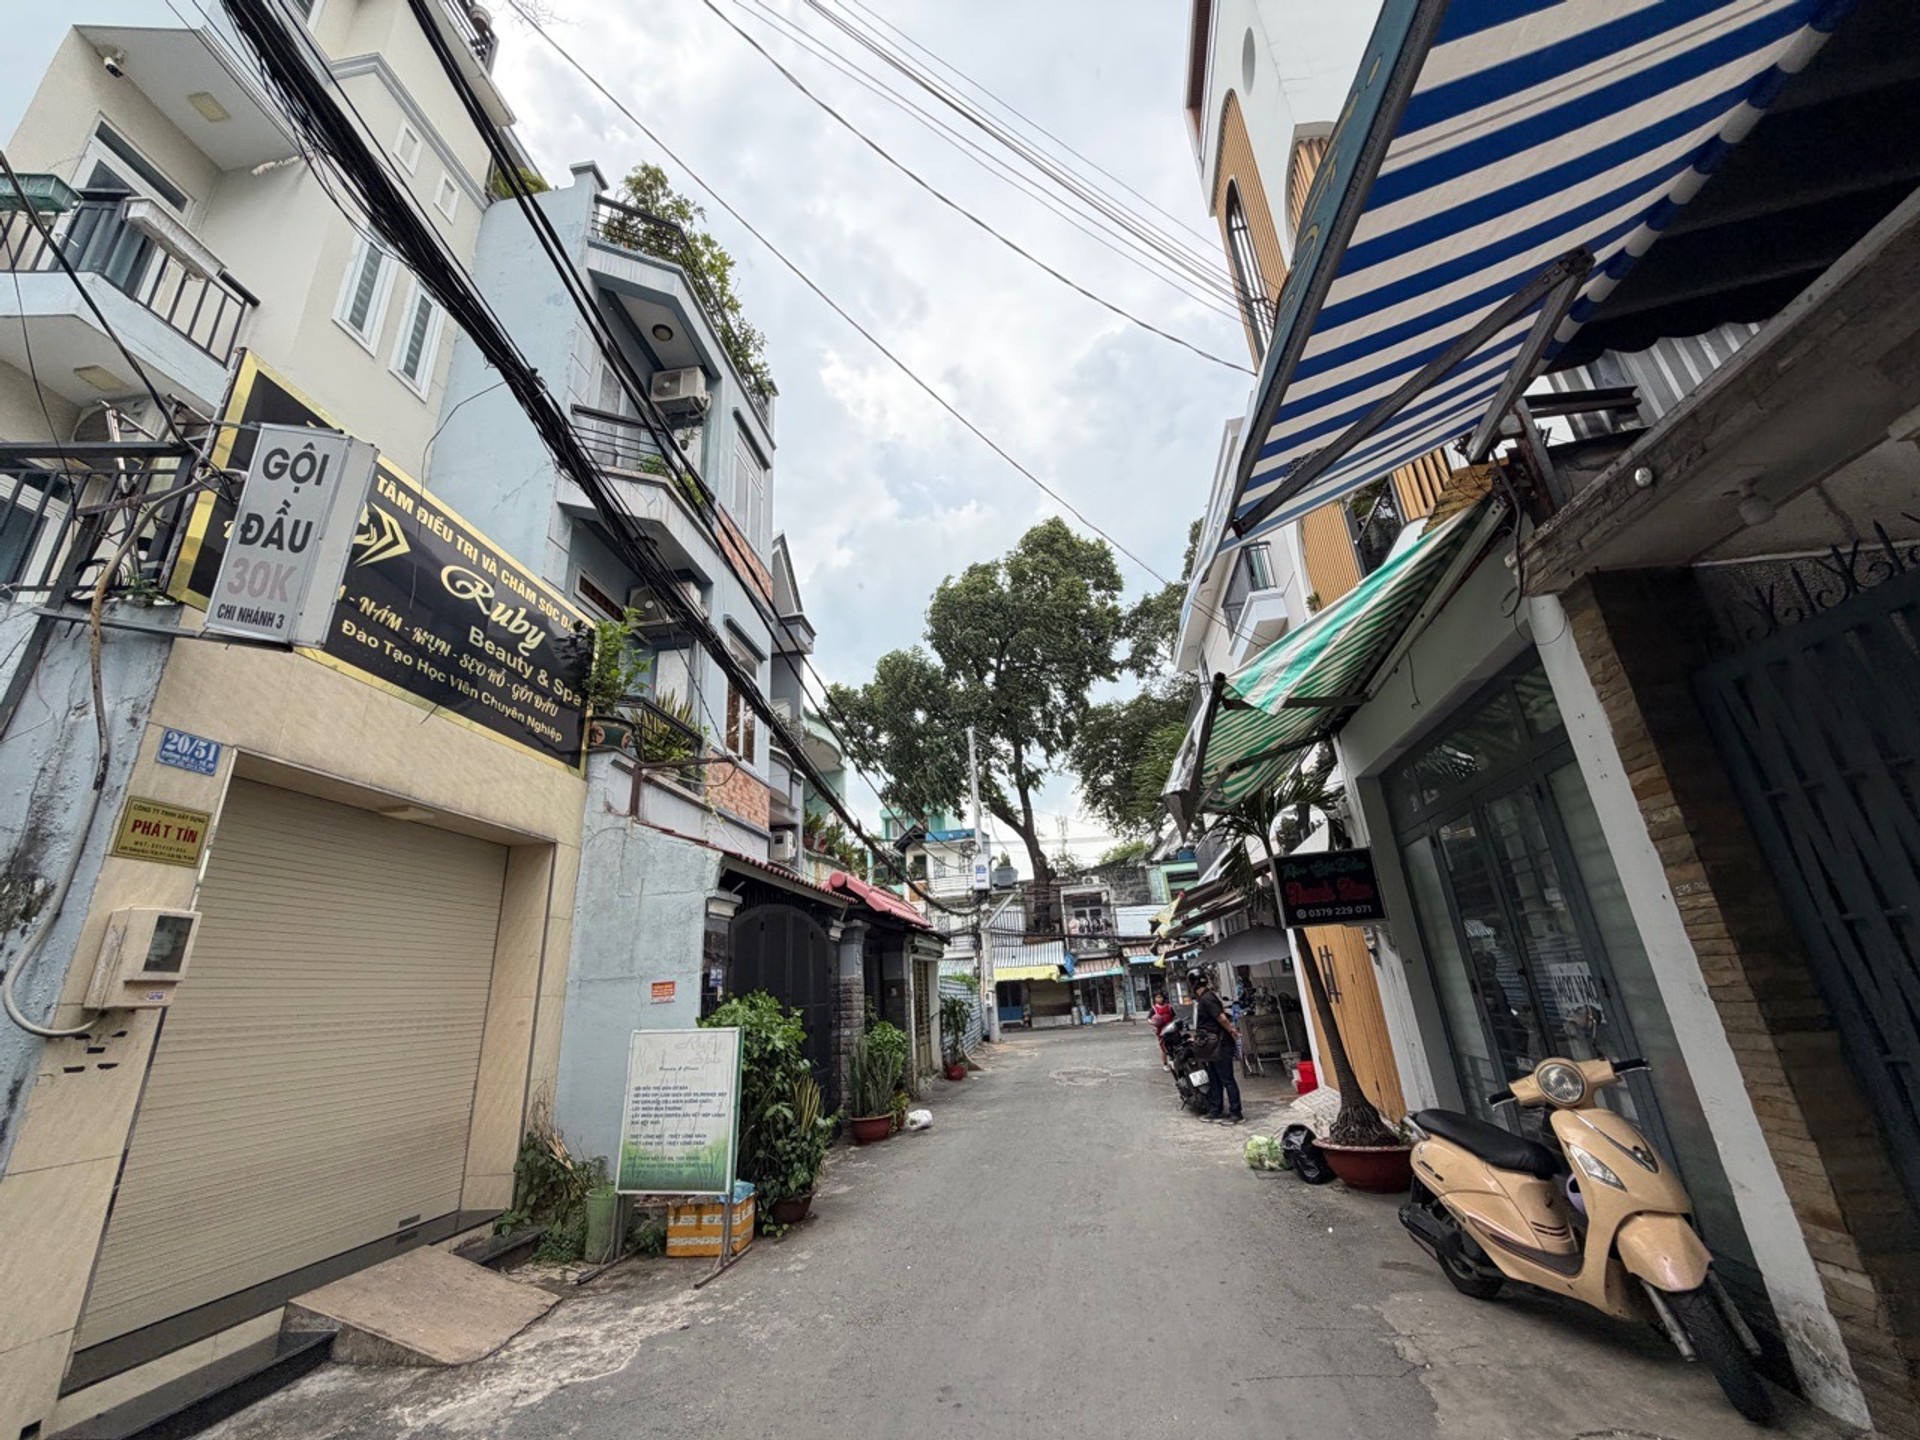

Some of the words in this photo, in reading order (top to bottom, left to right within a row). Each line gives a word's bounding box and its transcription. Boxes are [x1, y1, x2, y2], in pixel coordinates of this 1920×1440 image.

[263, 442, 330, 493] GỘI
[238, 500, 313, 553] ĐẦU
[377, 475, 414, 515] TÂM
[456, 534, 478, 565] TRỊ
[482, 553, 497, 577] VÀ
[501, 570, 537, 605] CHĂM
[538, 597, 560, 622] SÓC
[226, 557, 297, 602] 30K
[217, 604, 237, 621] CHI
[237, 606, 276, 628] NHÁNH
[276, 613, 285, 629] 3
[359, 596, 403, 632] NÁM
[441, 565, 546, 657] Ruby
[342, 620, 379, 648] Đào
[383, 640, 413, 666] Tạo
[417, 658, 447, 683] Học
[450, 674, 479, 699] Viên
[481, 692, 525, 722] Chuyên
[526, 715, 563, 743] Nghiệp
[468, 625, 535, 679] Beauty
[537, 669, 548, 688] &
[553, 678, 582, 707] Spa
[164, 731, 216, 762] 20/51
[130, 819, 172, 839] PHÁT
[176, 827, 199, 844] TÍN
[1308, 907, 1333, 918] 0379
[1335, 906, 1353, 916] 229
[1355, 904, 1372, 914] 071
